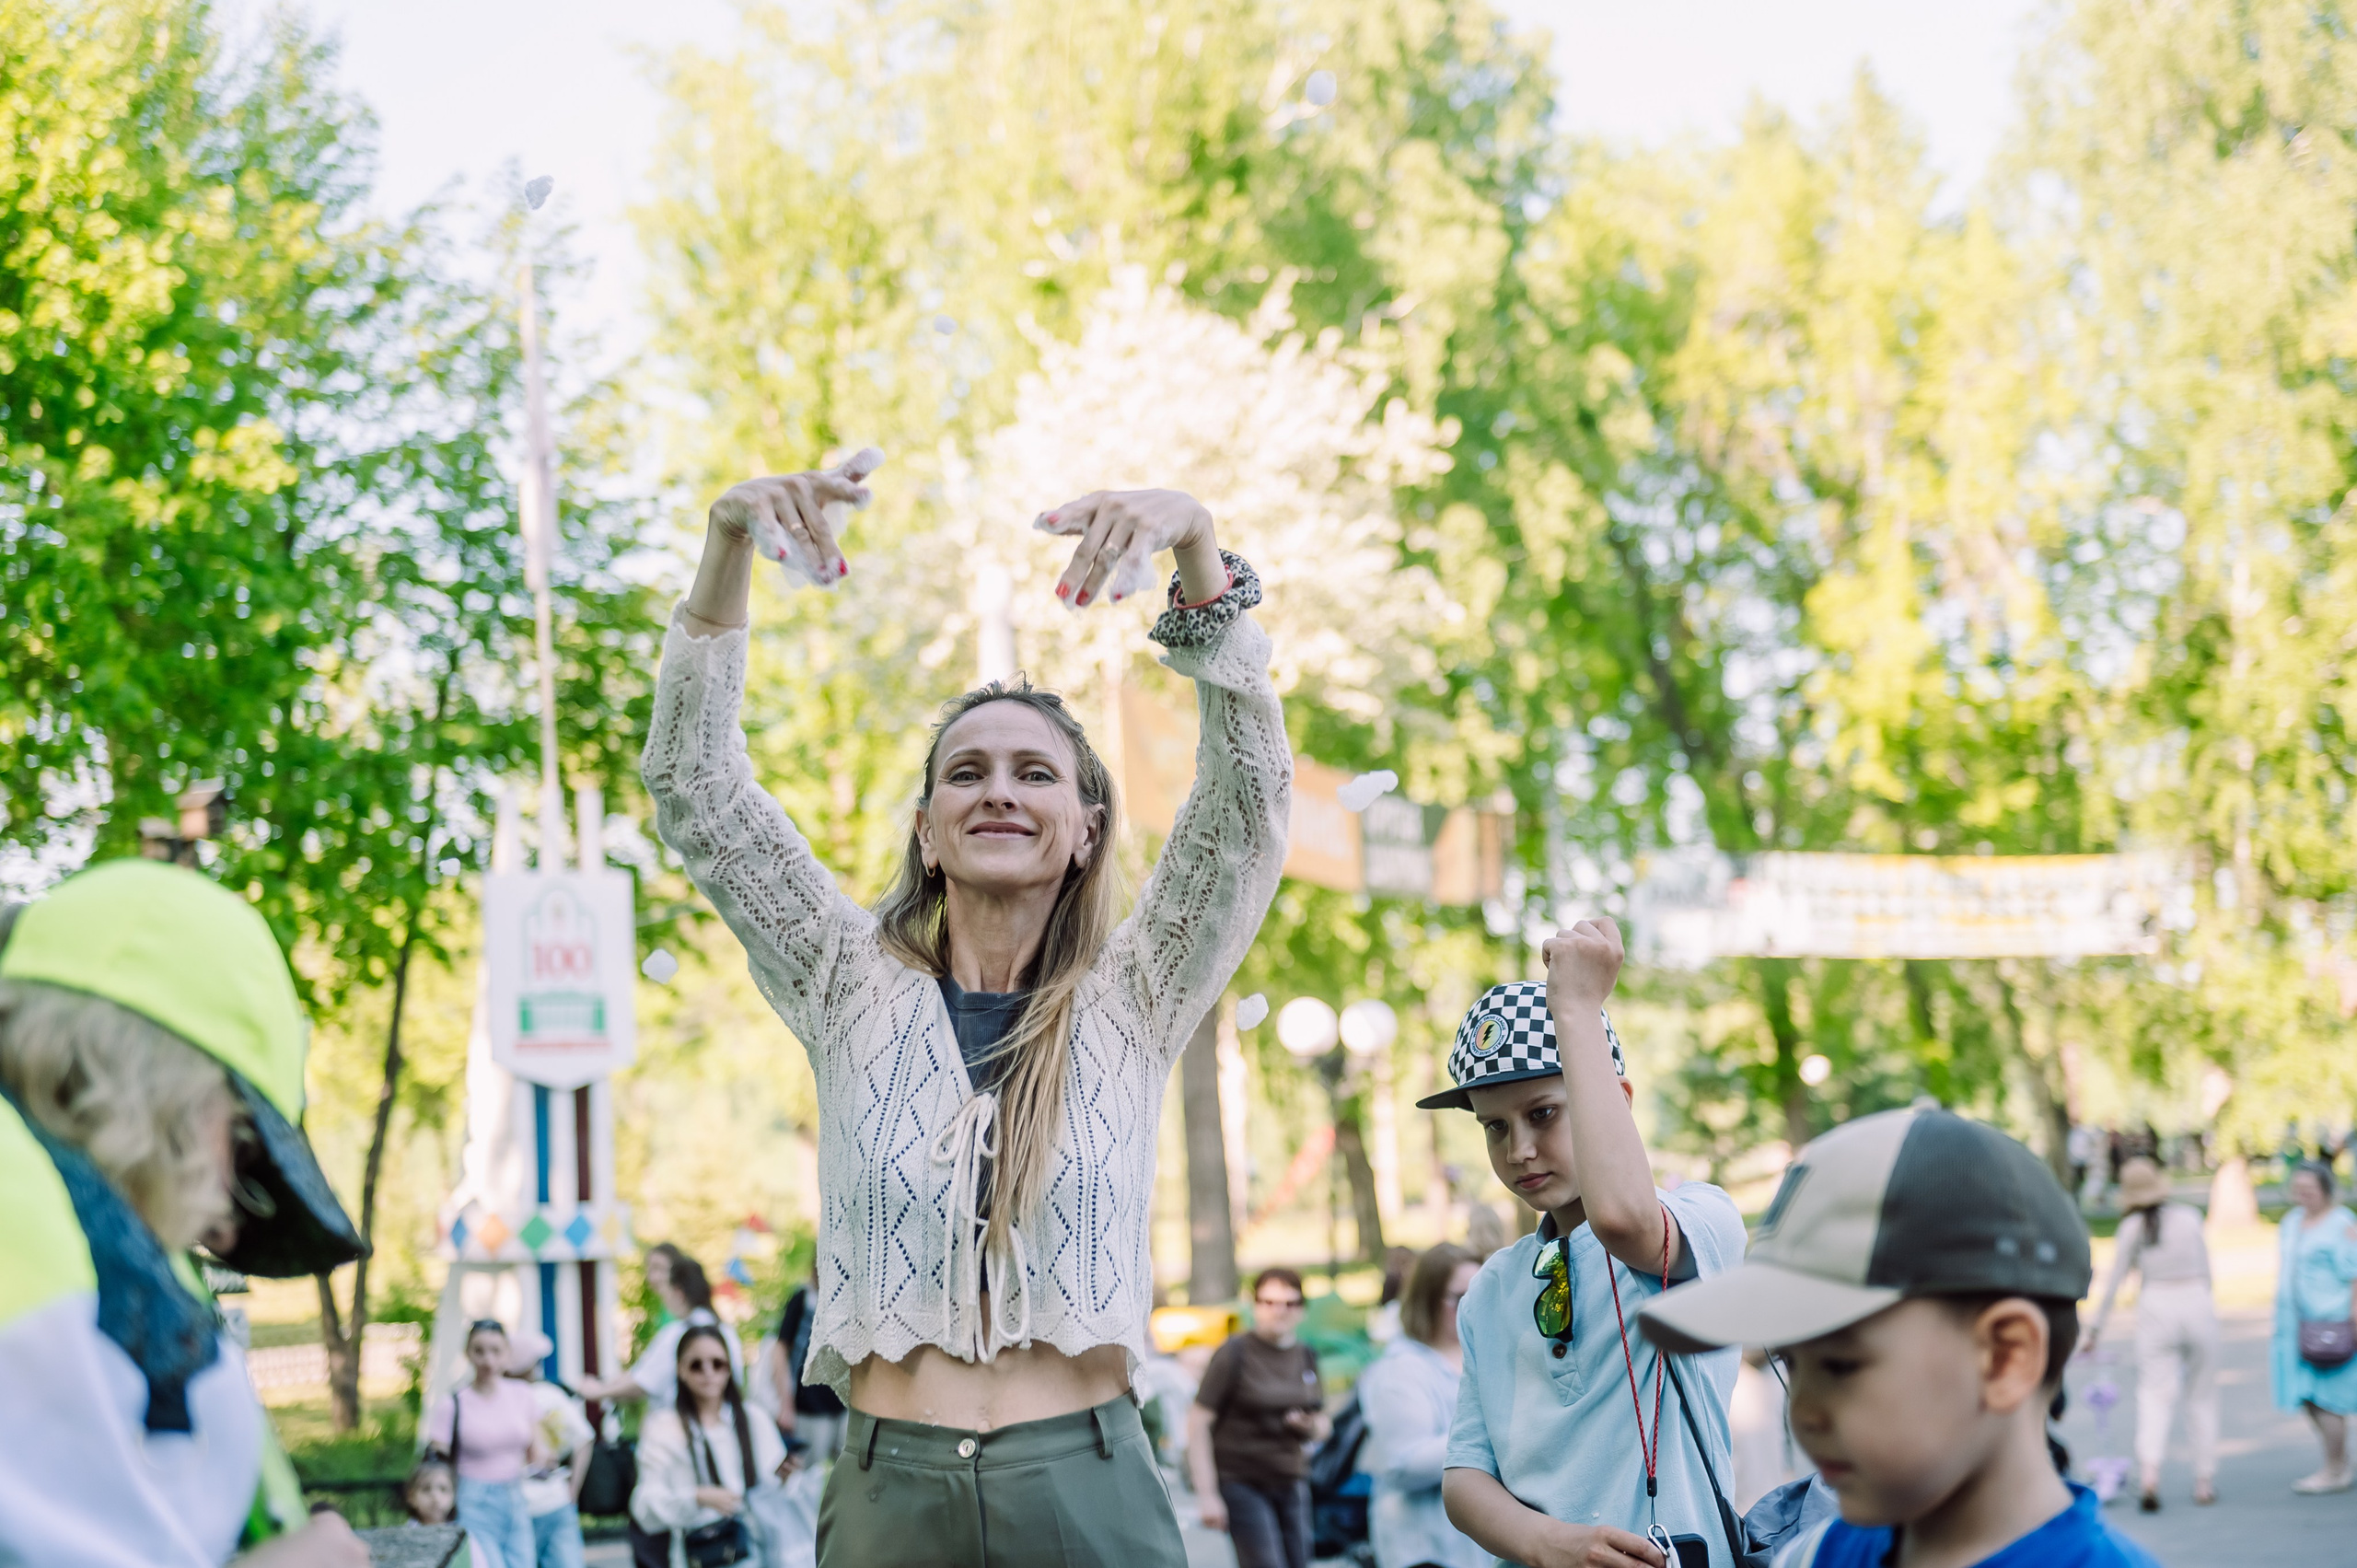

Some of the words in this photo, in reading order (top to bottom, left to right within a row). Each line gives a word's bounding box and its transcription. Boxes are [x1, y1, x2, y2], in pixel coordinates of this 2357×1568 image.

[532, 939, 593, 981] 100
[1495, 1016, 1506, 1030] LEAGUE
[1492, 1035, 1505, 1051] WORLD
